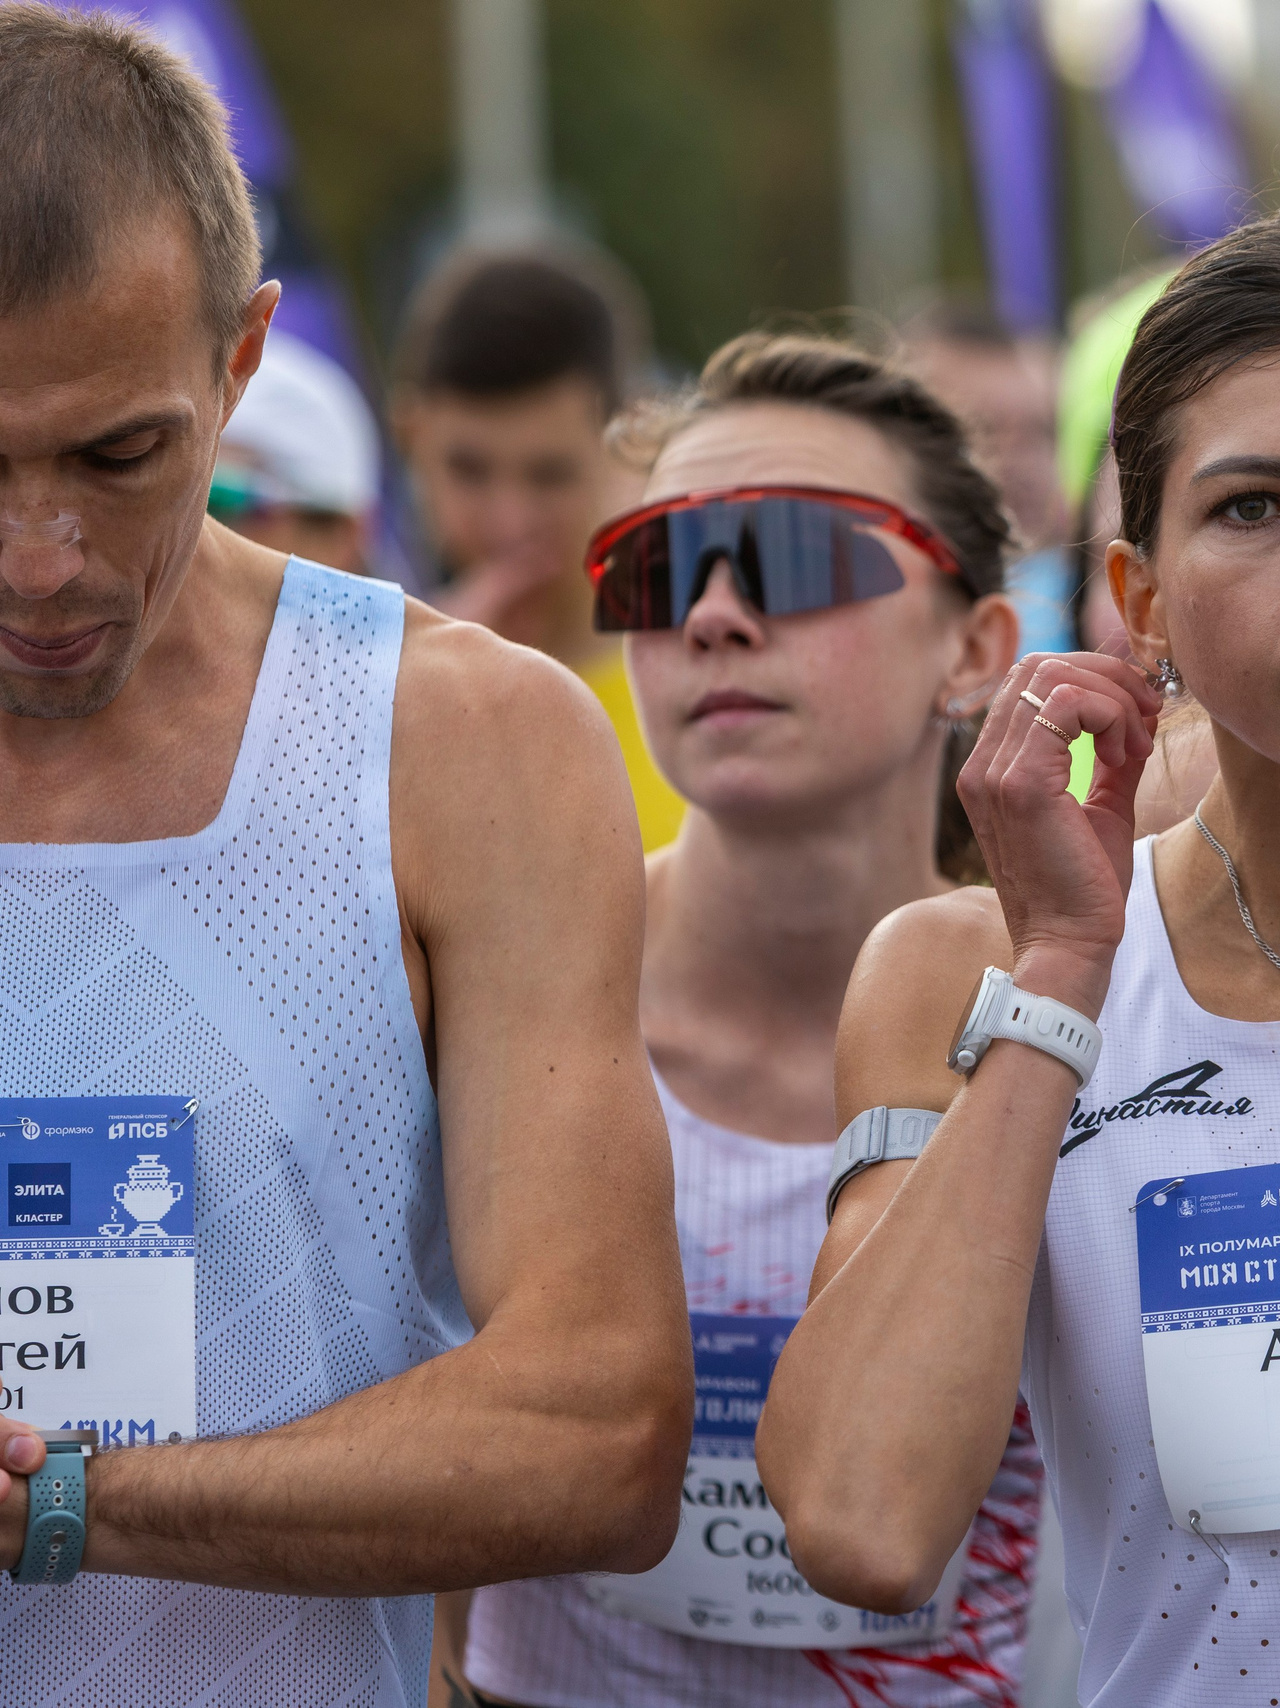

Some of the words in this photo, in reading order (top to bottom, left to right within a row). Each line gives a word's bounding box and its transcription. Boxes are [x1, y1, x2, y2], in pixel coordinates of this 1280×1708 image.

[44, 1126, 94, 1137] фармэко
[128, 1122, 168, 1139] ПСБ
[14, 1184, 65, 1197] ЭЛИТА
[1199, 1191, 1238, 1202] Департамент
[16, 1213, 63, 1223] КЛАСТЕР
[1180, 1261, 1238, 1289] МОЯ
